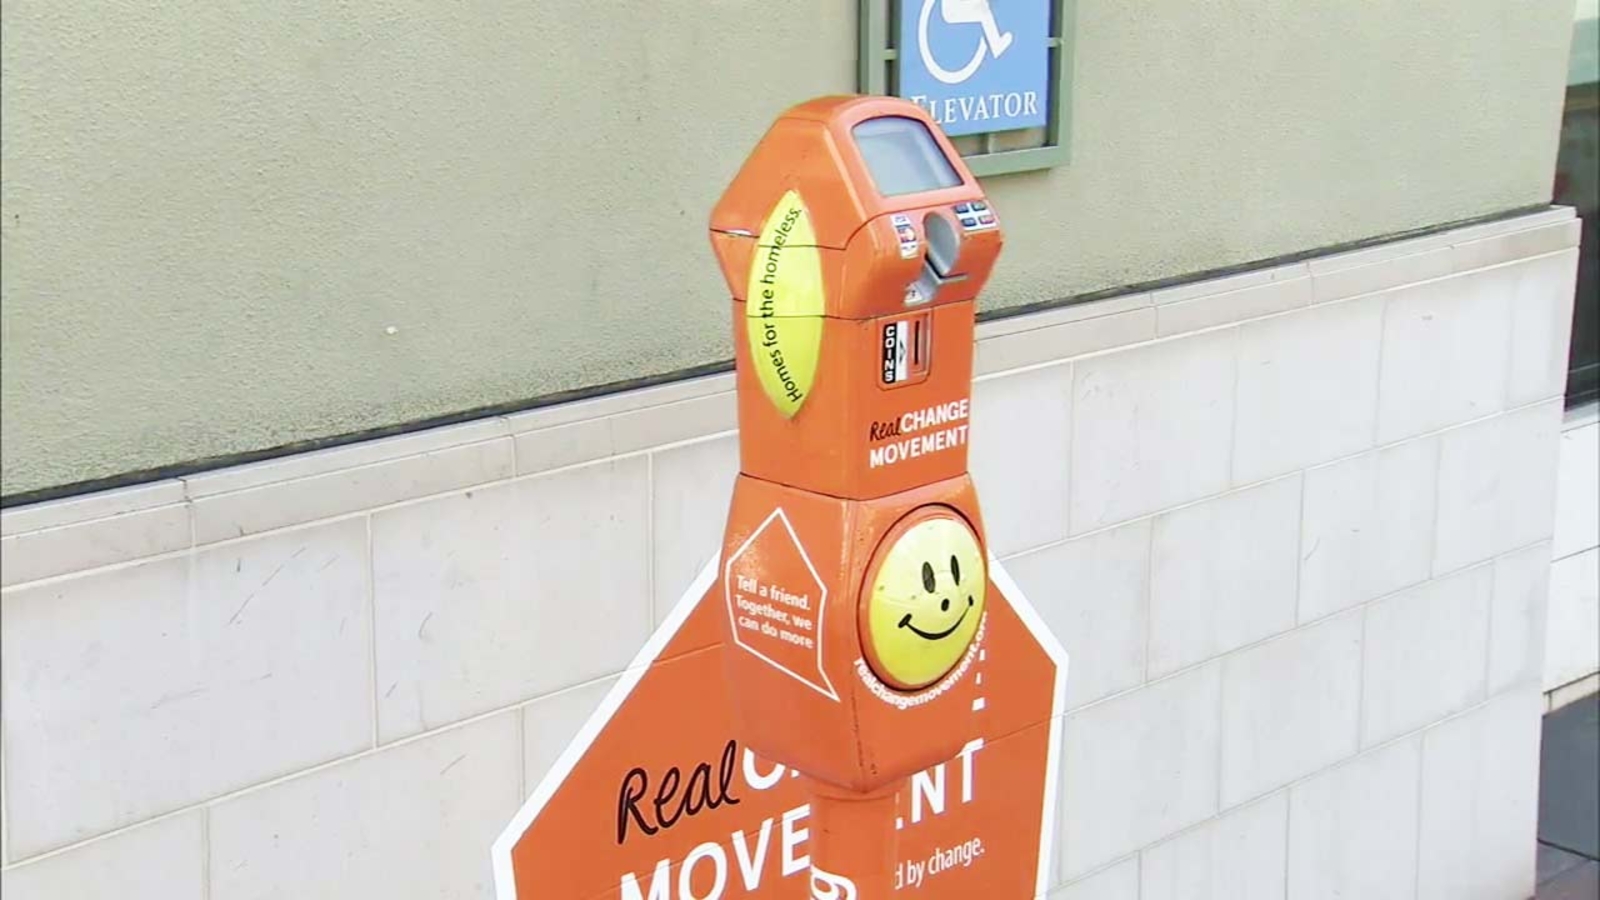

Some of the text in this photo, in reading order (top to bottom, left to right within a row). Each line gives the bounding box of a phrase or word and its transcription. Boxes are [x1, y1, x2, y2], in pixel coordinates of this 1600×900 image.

[759, 208, 803, 402] Homes for the homeless.
[884, 325, 896, 383] COINS
[869, 425, 970, 469] MOVEMENT
[735, 594, 813, 631] Together, we
[736, 574, 811, 611] Tell a friend.
[738, 616, 814, 649] can do more
[907, 860, 926, 888] by
[928, 837, 985, 875] change.
